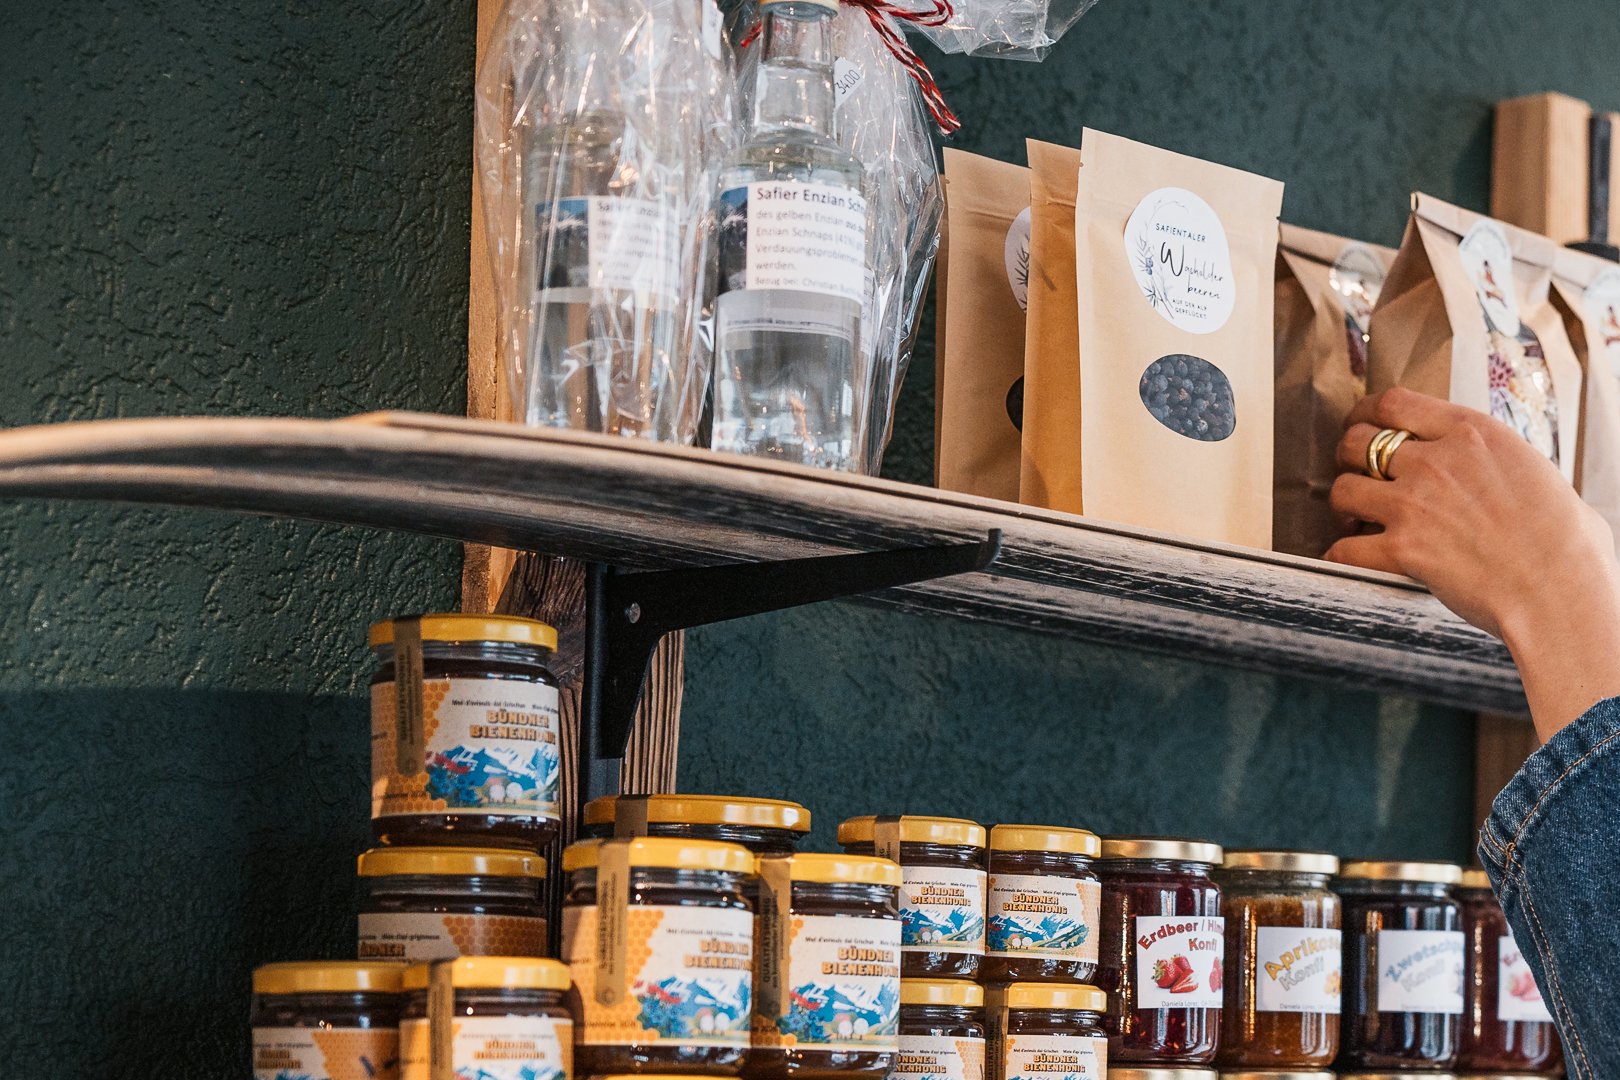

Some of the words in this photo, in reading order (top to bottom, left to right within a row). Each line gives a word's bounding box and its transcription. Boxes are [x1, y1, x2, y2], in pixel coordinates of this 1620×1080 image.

[757, 187, 798, 200] Safier
[803, 189, 845, 207] Enzian
[1155, 223, 1206, 243] SAFIENTALER
[920, 885, 965, 898] BÜNDNER
[911, 895, 972, 907] BIENENHONIG
[1012, 893, 1059, 906] BÜNDNER
[1002, 902, 1068, 915] BIENENHONIG
[762, 897, 770, 984] QUALITÄTSHONIG
[1138, 922, 1199, 950] Erdbeer
[1189, 938, 1217, 952] Konfi
[838, 945, 894, 963] BÜNDNER
[1279, 956, 1324, 992] Konfi
[896, 1053, 938, 1065] ÜNDNER
[1032, 1053, 1078, 1064] BÜNDNER
[895, 1064, 947, 1074] NENHONIG
[1023, 1063, 1086, 1073] BIENENHONIG
